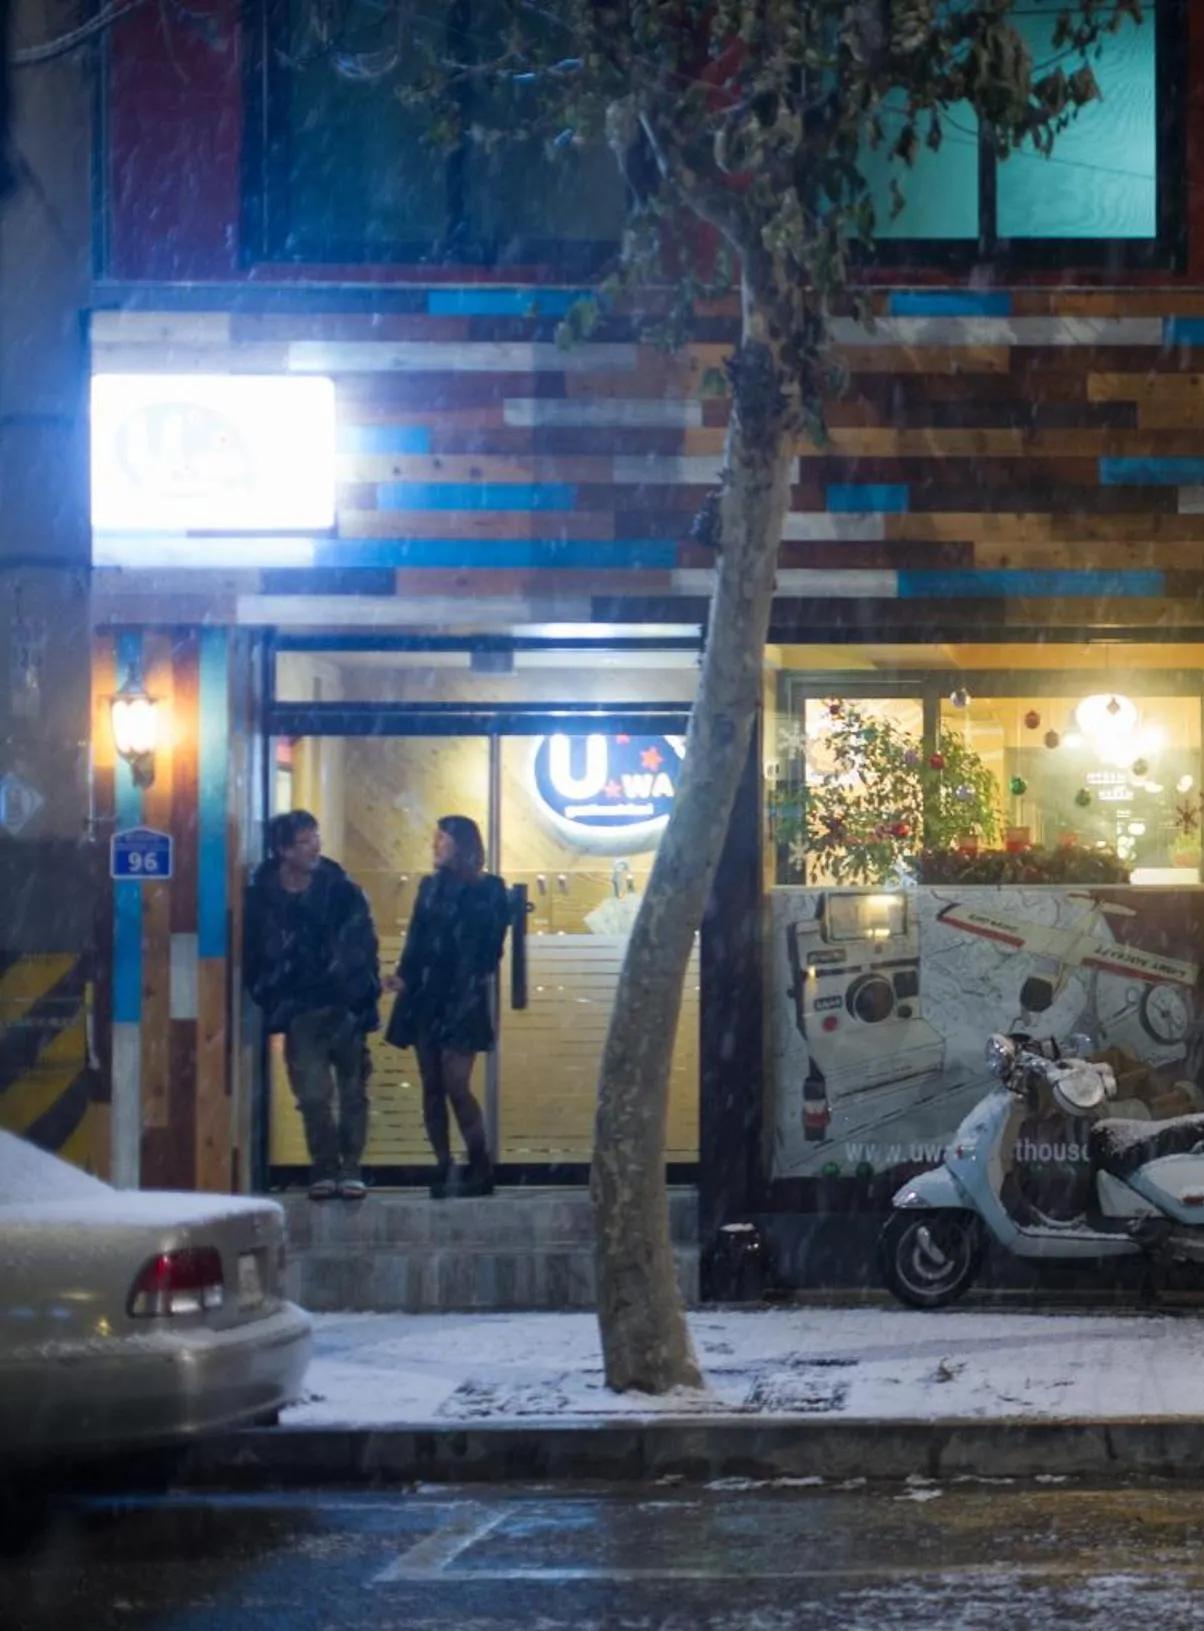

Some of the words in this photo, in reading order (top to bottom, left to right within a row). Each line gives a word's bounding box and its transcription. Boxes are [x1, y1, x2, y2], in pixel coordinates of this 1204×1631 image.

[549, 733, 608, 800] U
[621, 772, 675, 798] WA
[128, 852, 158, 872] 96
